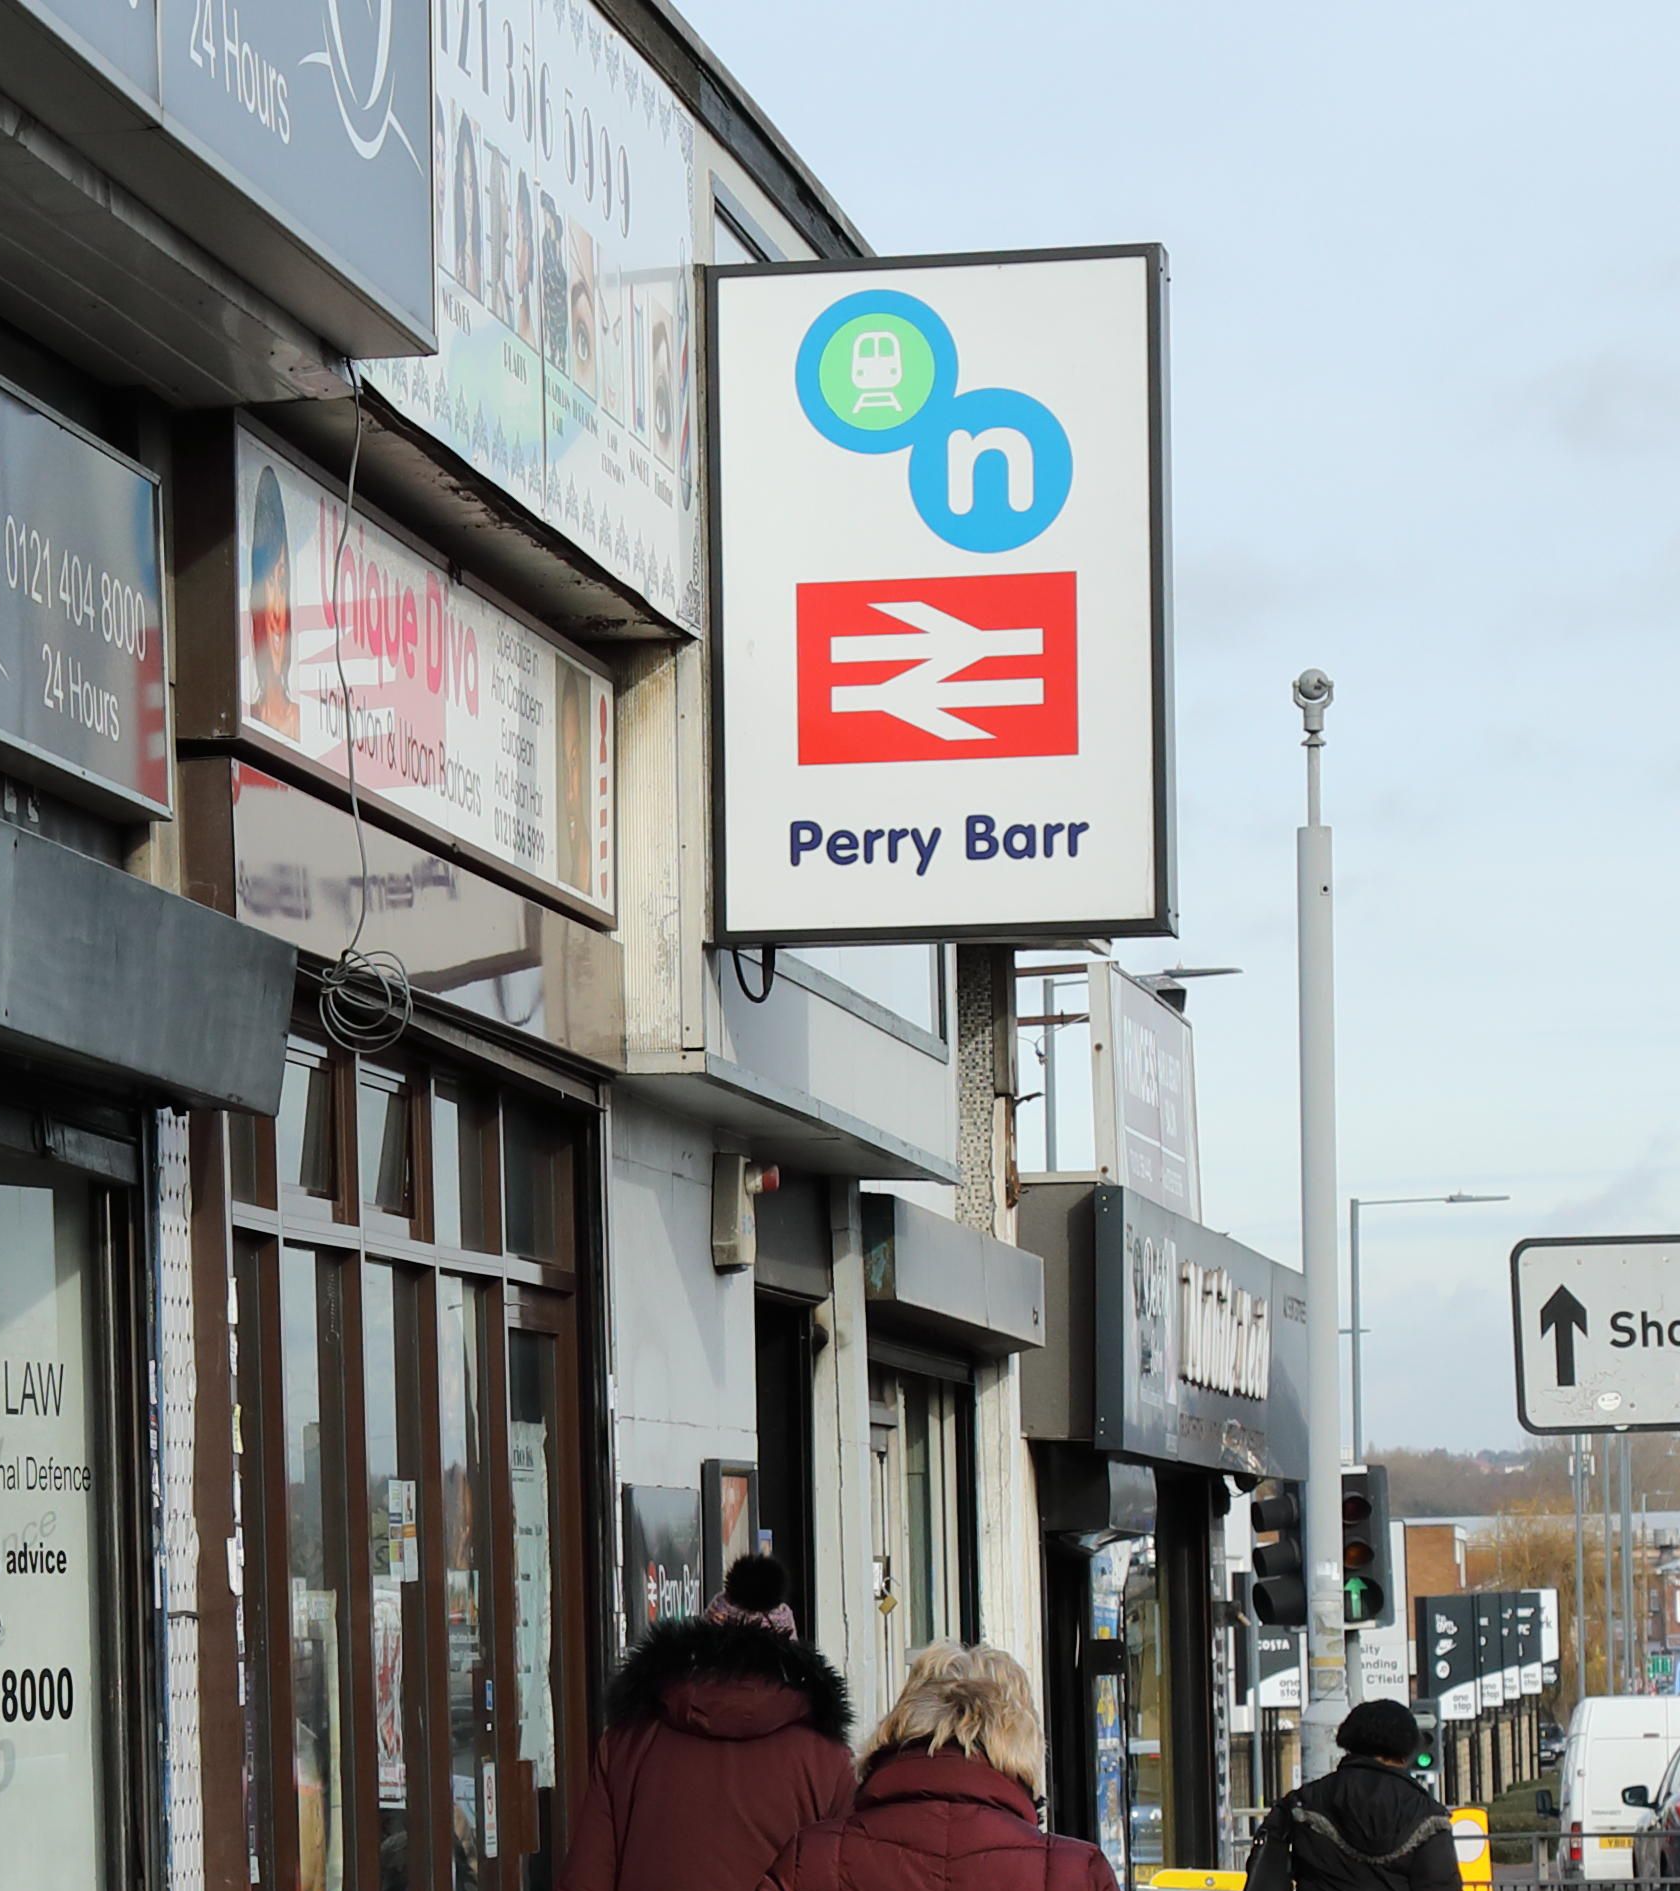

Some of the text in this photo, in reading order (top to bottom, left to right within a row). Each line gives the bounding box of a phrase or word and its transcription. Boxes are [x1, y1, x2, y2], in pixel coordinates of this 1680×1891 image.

[223, 0, 291, 145] Hours
[502, 19, 630, 239] 356 5999
[5, 515, 146, 661] 0121 404 8000
[319, 496, 481, 721] Unique Diva
[42, 644, 119, 741] 24 Hours
[438, 742, 482, 818] Barbers
[790, 814, 1090, 877] Perry Barr
[4, 1363, 65, 1417] LAW
[25, 1460, 92, 1493] Defence
[5, 1542, 67, 1575] advice
[659, 1564, 681, 1617] Perry
[1, 1667, 74, 1721] 8000
